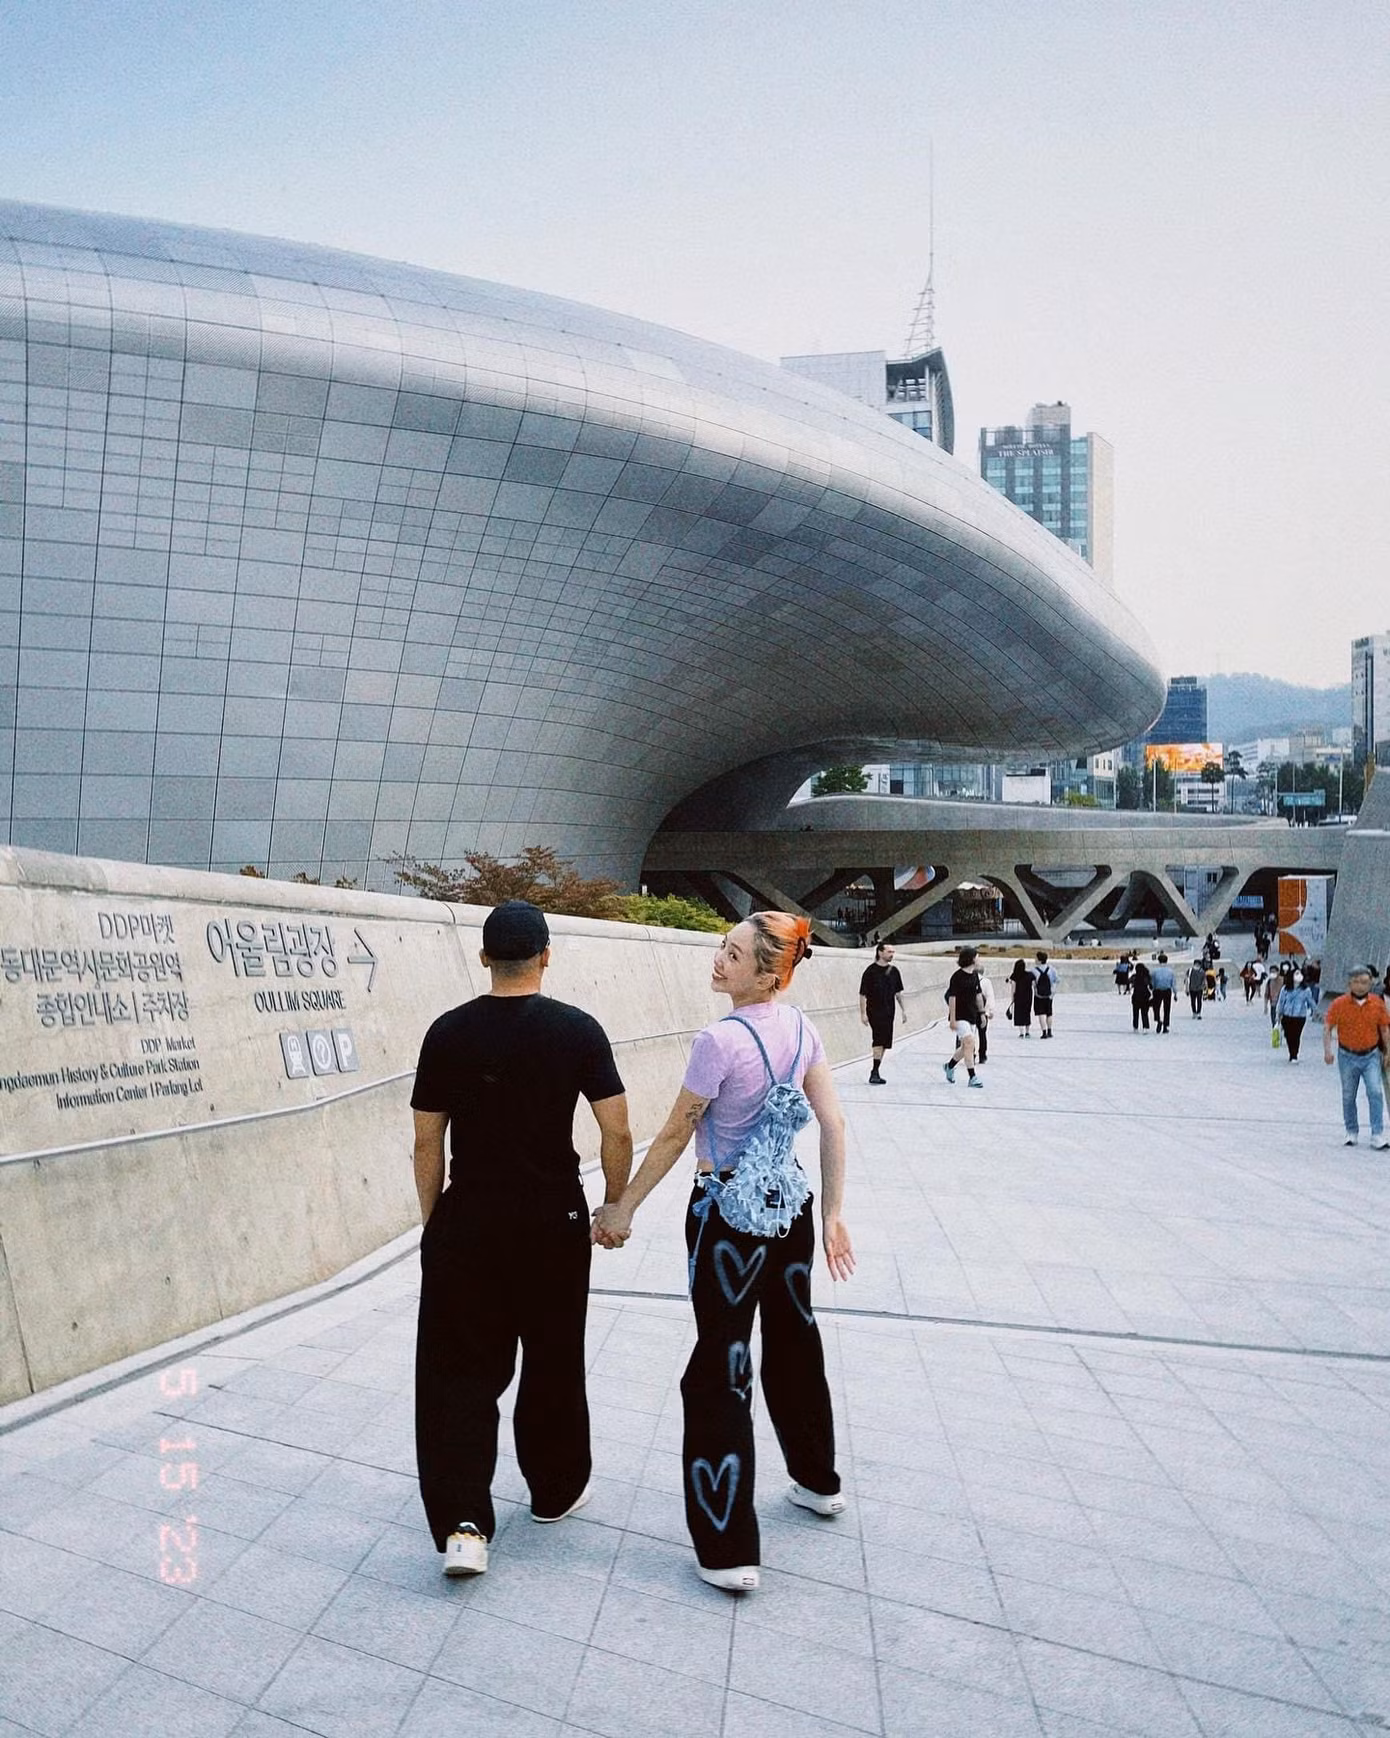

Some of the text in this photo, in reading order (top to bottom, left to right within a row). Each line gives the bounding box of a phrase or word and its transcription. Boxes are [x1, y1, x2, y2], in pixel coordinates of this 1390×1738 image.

[97, 912, 175, 944] DDP마켓
[206, 918, 339, 978] 어울림광장
[0, 947, 184, 984] 동대문역사문화공원역
[37, 992, 132, 1028] 종합안내소
[142, 989, 190, 1022] 주차장
[253, 990, 346, 1013] OULLIM SQUARE
[140, 1036, 196, 1054] DDP Market
[61, 1066, 99, 1084] History
[100, 1063, 109, 1081] &
[109, 1061, 145, 1080] Culture
[146, 1058, 168, 1075] Park
[168, 1057, 200, 1073] Station
[56, 1086, 115, 1111] Information
[116, 1085, 148, 1103] Center
[155, 1080, 189, 1098] Parking
[189, 1078, 204, 1094] Lot
